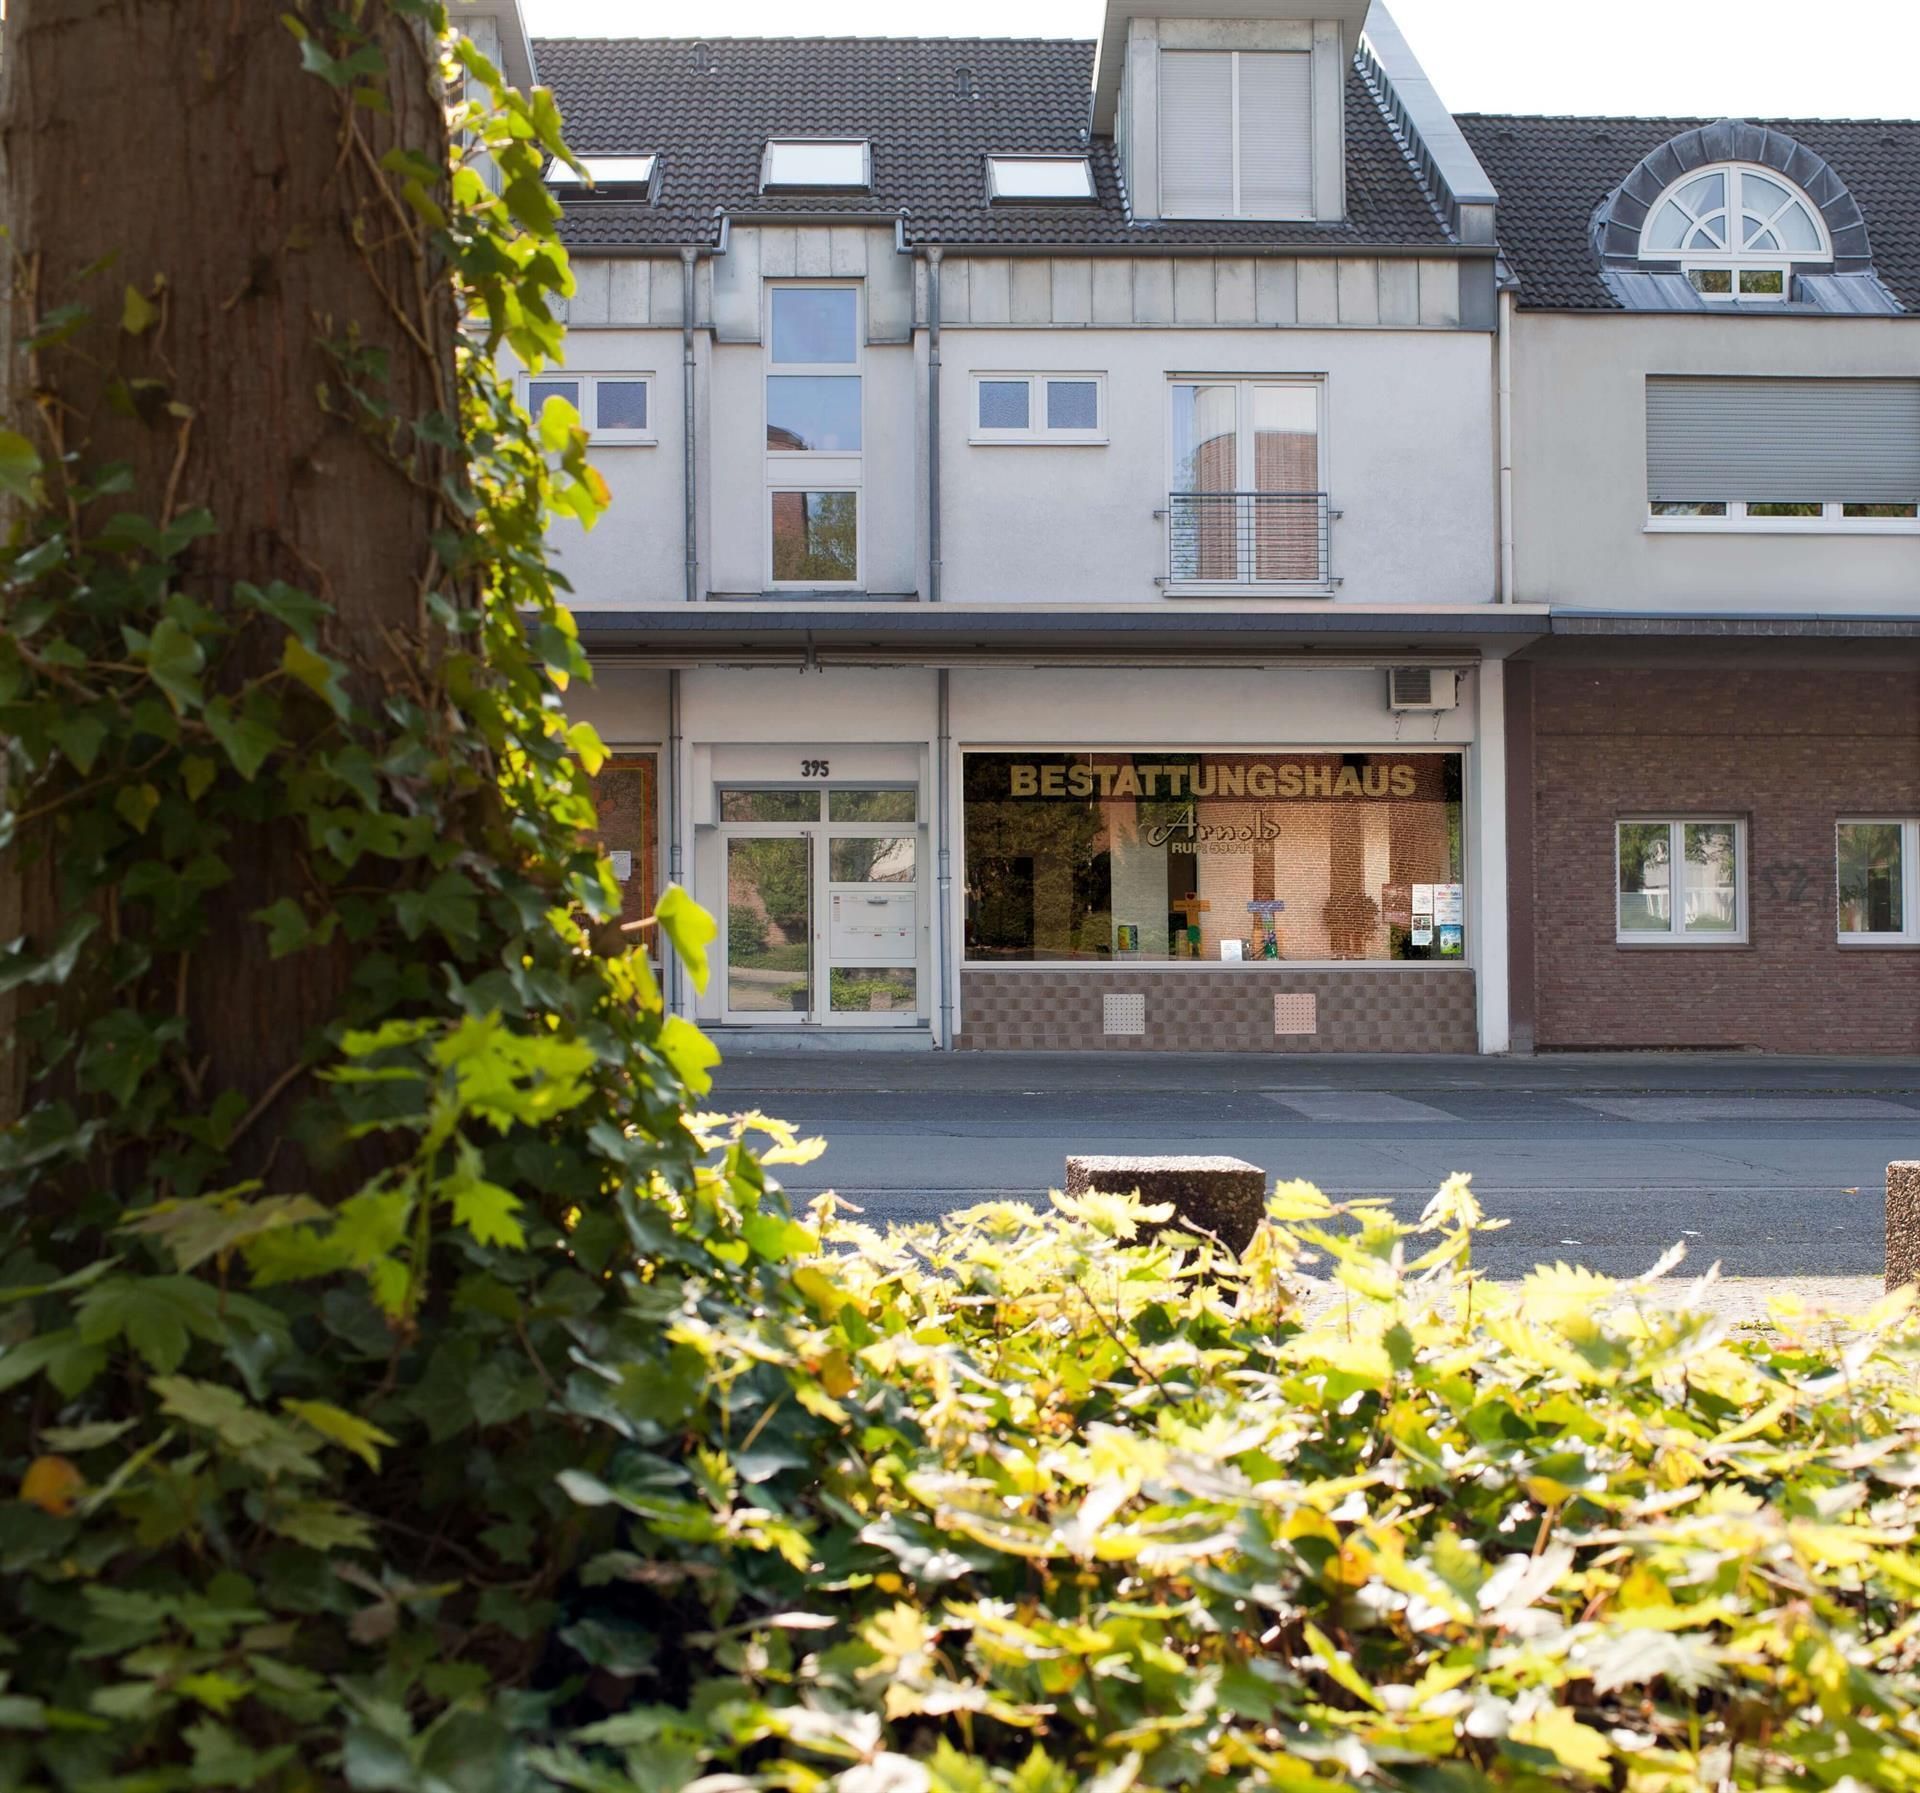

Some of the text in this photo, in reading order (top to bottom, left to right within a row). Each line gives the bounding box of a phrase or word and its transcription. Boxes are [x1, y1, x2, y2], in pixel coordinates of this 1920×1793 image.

[801, 760, 829, 777] 395
[1010, 764, 1417, 797] BESTATTUNGSHAUS
[1146, 803, 1281, 847] Arnold
